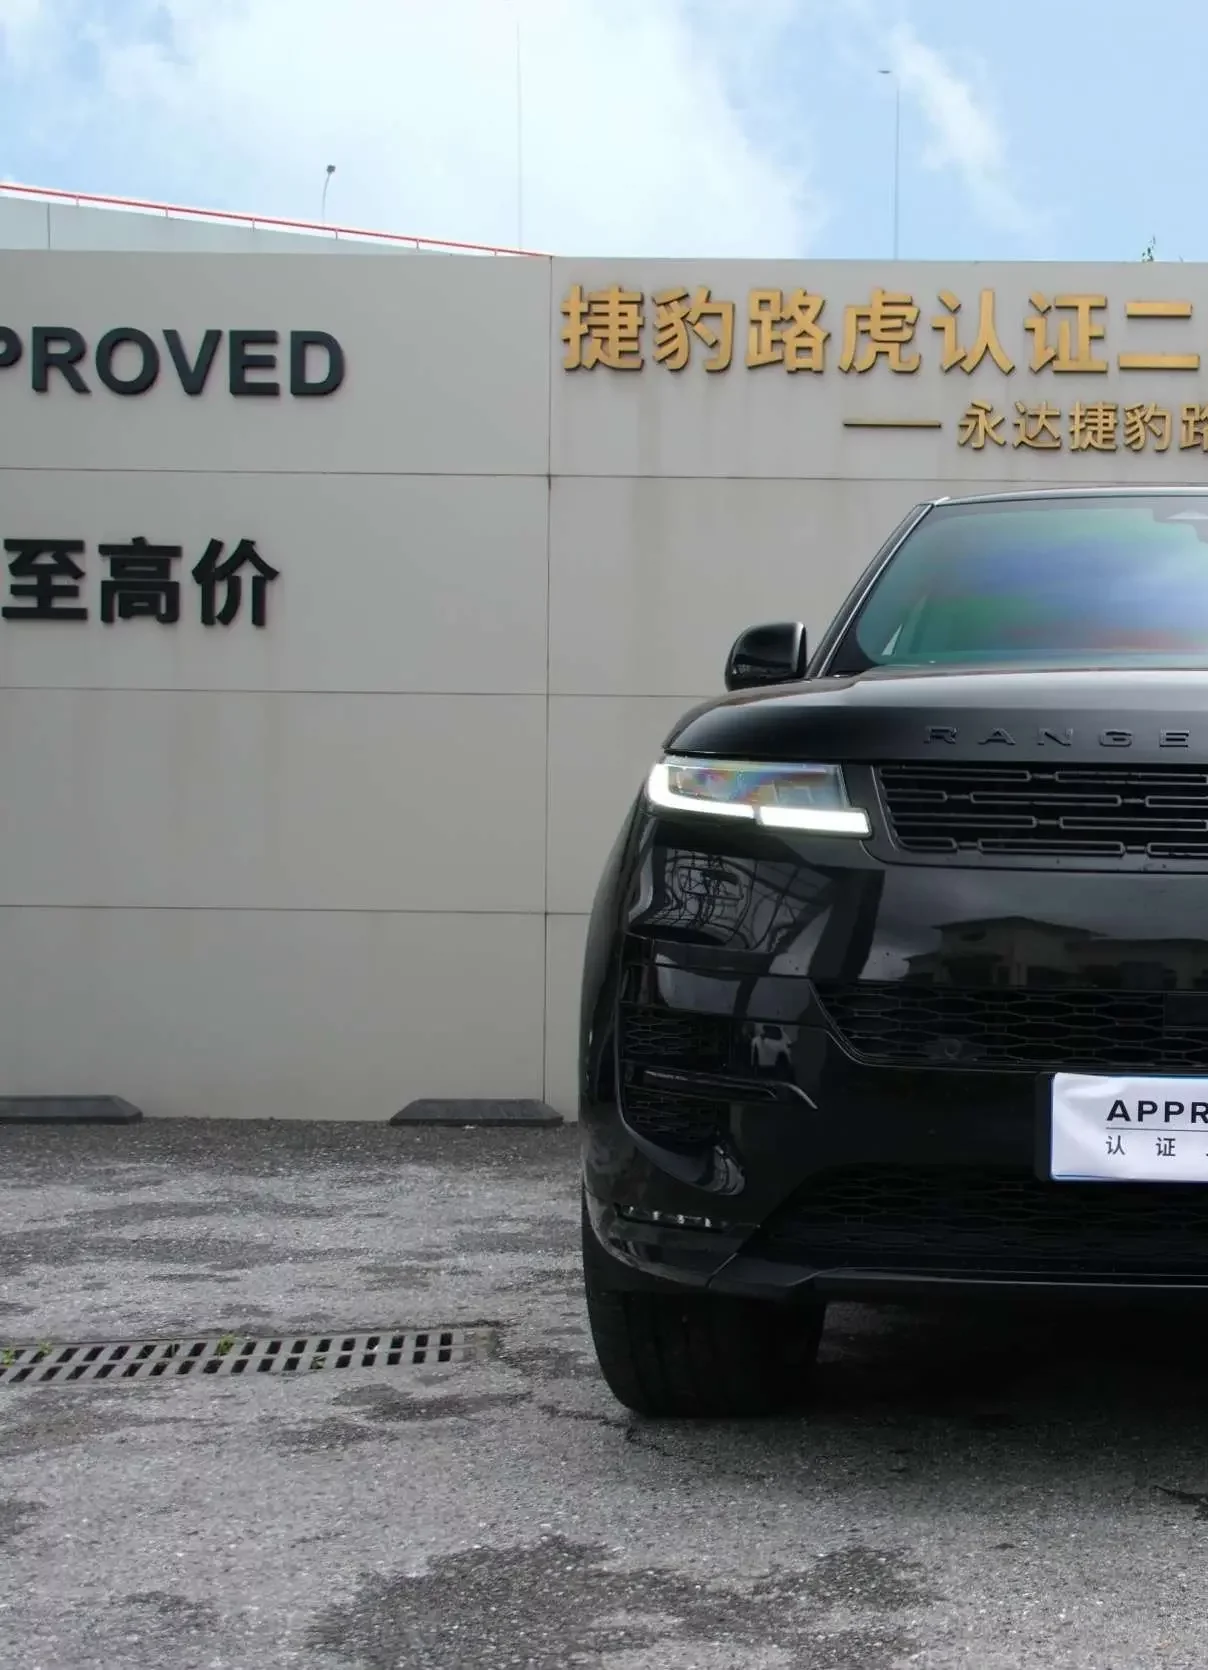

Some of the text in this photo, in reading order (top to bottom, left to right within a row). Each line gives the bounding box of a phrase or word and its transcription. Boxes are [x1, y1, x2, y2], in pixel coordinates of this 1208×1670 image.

[2, 536, 279, 627] 至高价
[924, 726, 1192, 750] RANGE
